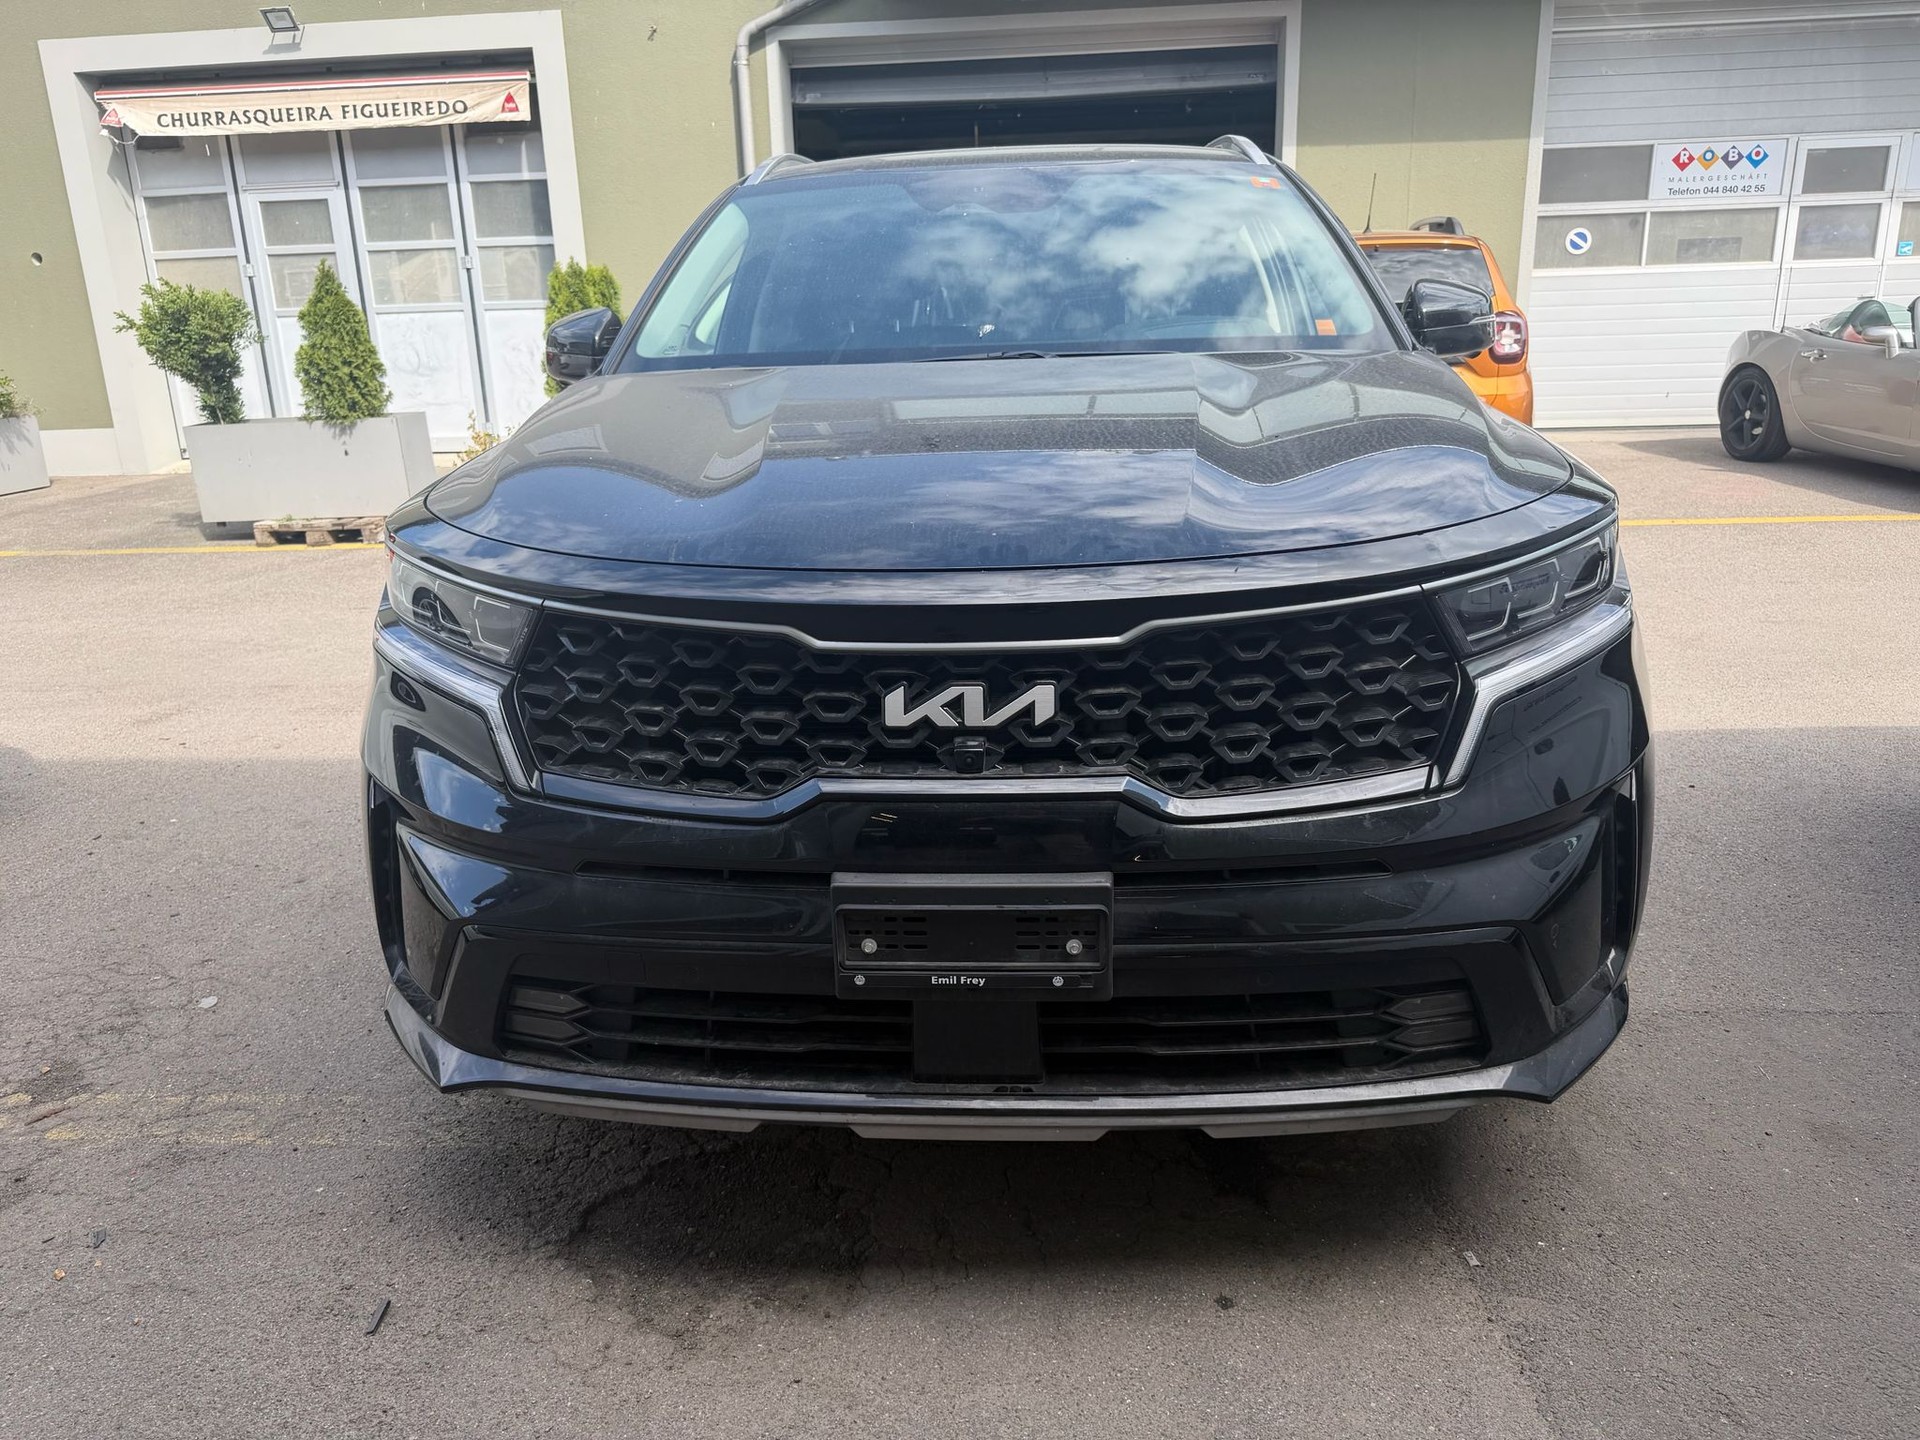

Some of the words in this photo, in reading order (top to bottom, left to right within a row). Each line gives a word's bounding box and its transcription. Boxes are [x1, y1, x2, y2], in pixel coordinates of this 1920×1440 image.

[156, 105, 333, 128] CHURRASQUEIRA
[341, 99, 469, 120] FIGUEIREDO
[1679, 146, 1766, 164] ROBO
[1667, 187, 1701, 196] Telefon
[1702, 186, 1720, 195] 044
[1721, 185, 1739, 194] 840
[1740, 184, 1752, 193] 42
[1754, 184, 1766, 193] 55
[884, 684, 1056, 727] KIA
[931, 976, 957, 984] Emil
[960, 976, 986, 987] Frey
